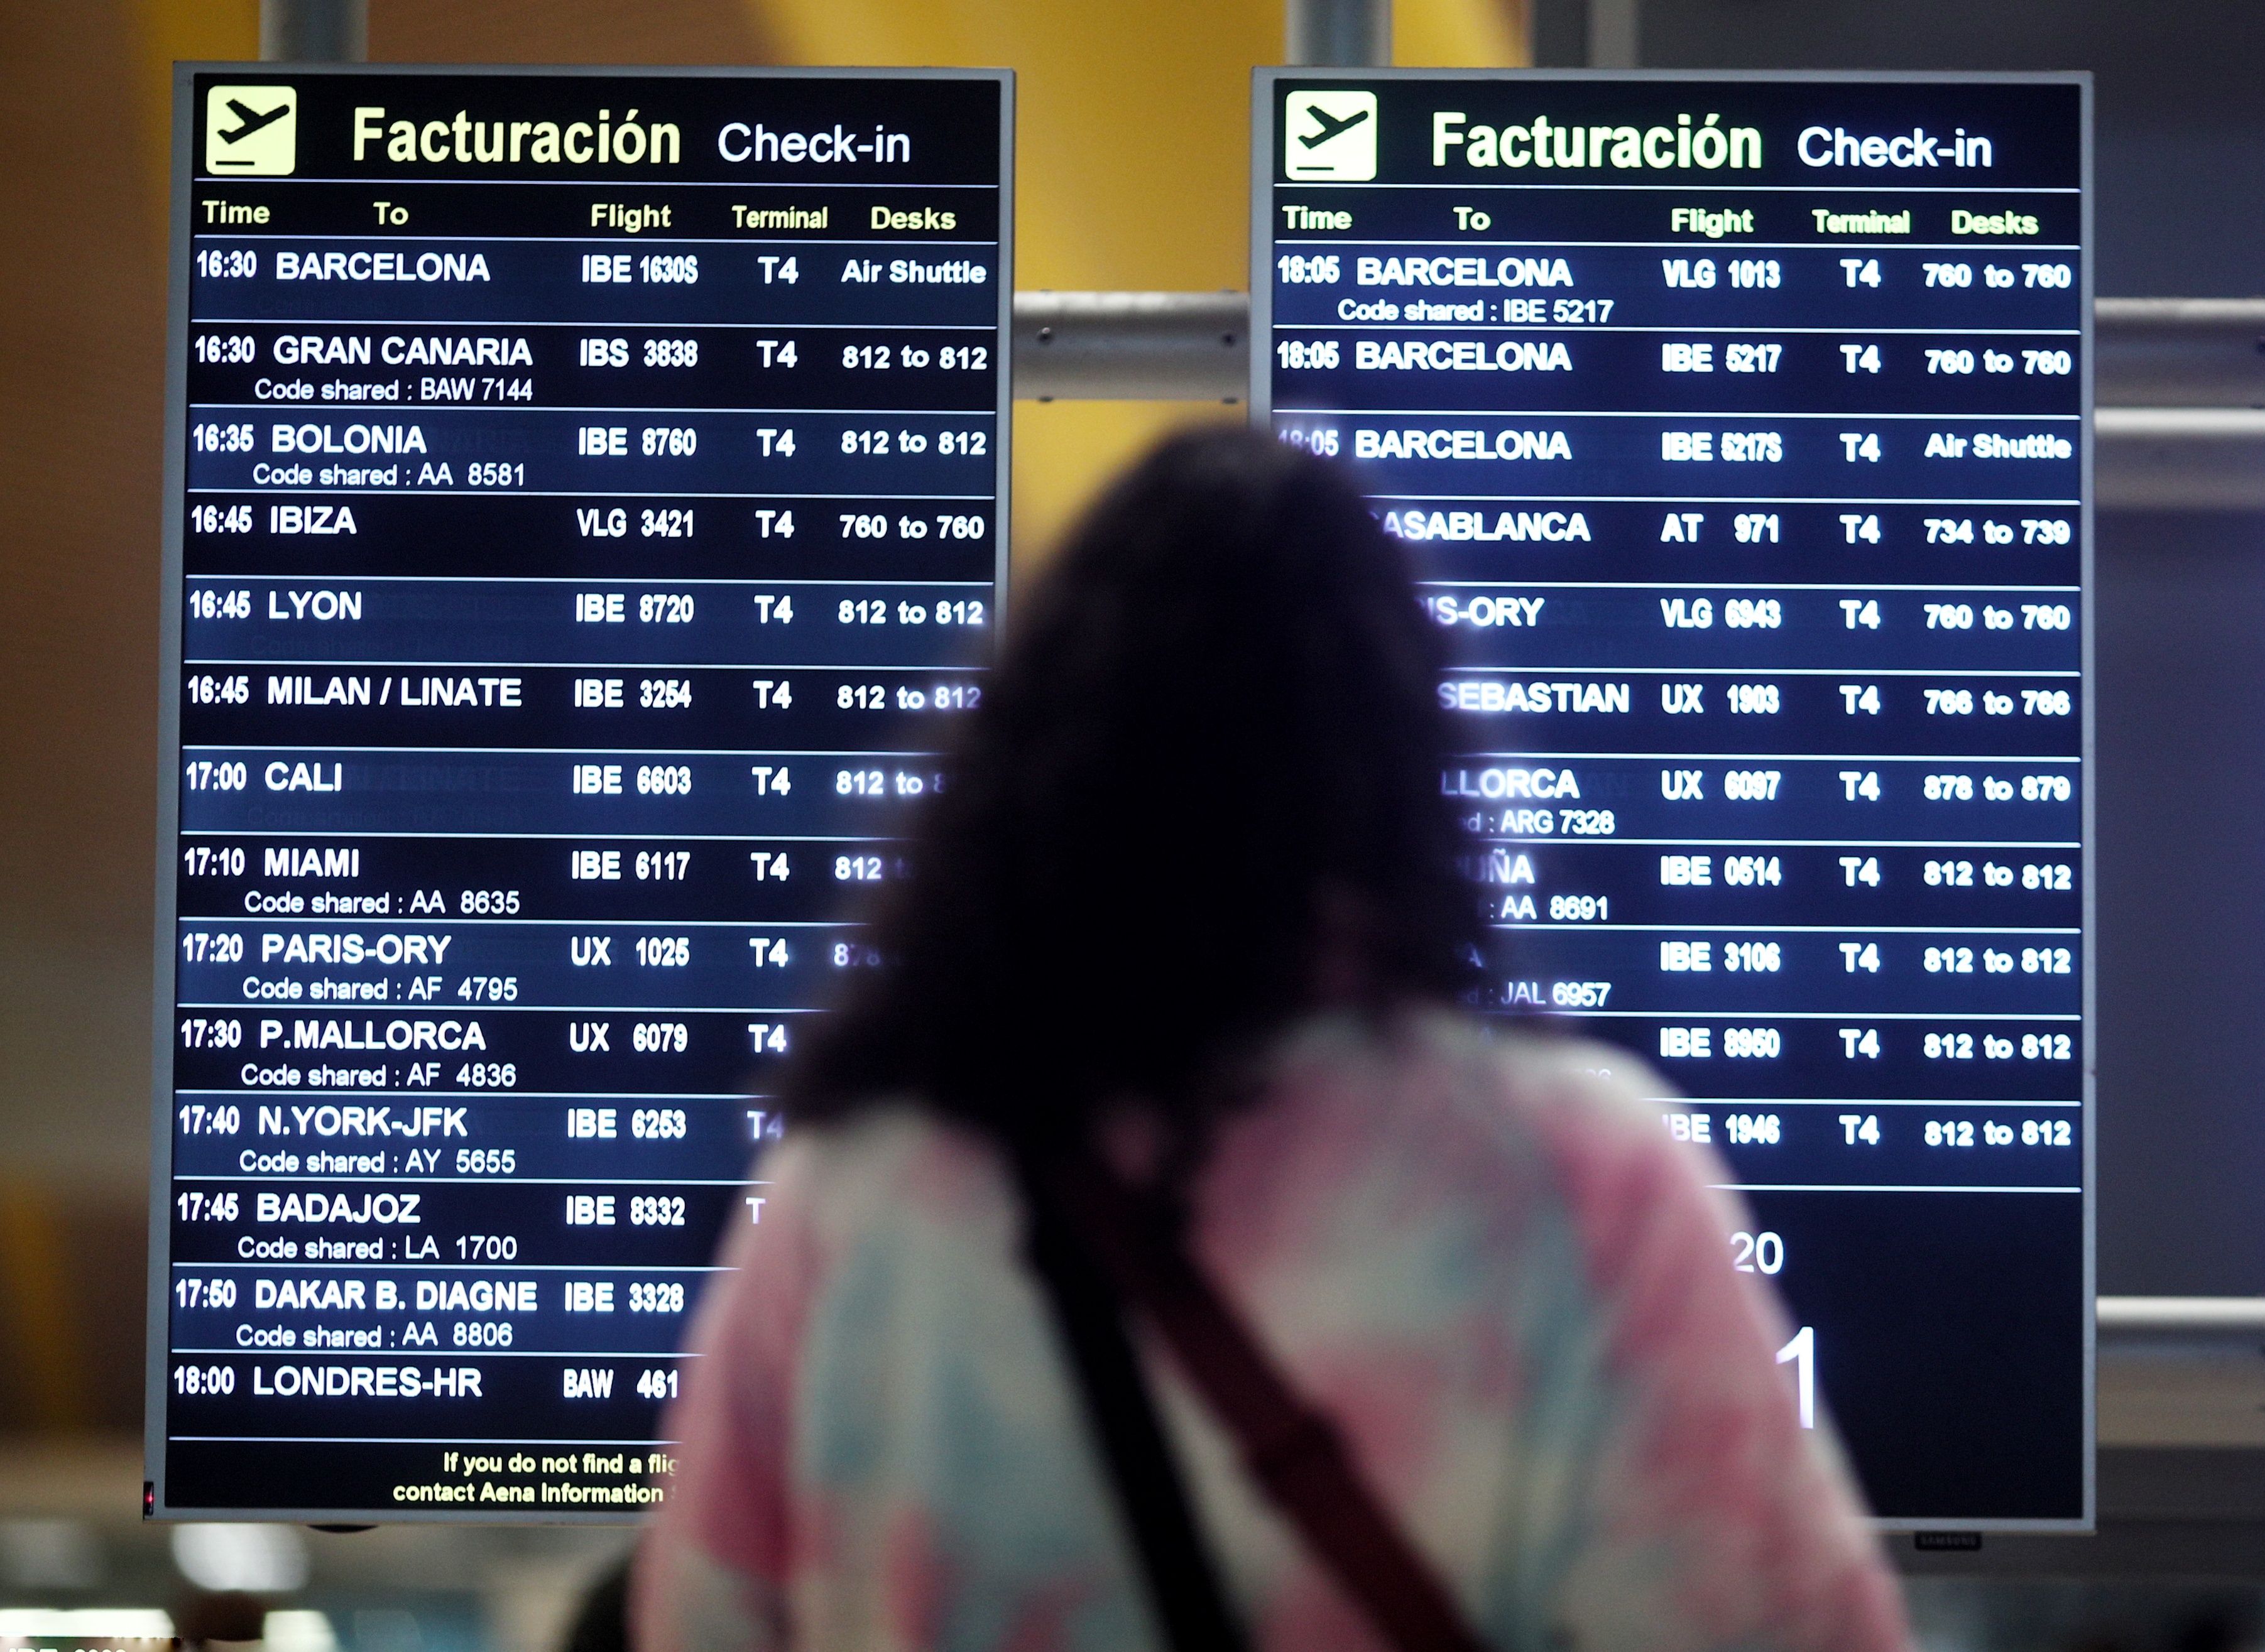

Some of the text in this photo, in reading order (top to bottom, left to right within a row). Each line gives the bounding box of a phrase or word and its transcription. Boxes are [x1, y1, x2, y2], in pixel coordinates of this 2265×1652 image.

[354, 107, 910, 164] Facturación Check-in
[1433, 112, 1992, 169] Facturación Check-in
[202, 200, 956, 233] Time To Flight Terminal Desks
[1282, 205, 2039, 239] Time To Flight Terminal Desks
[197, 249, 987, 285] 16:30 BARCELONA IBE 1630S T4 Air Shuttle
[1277, 254, 2072, 289] 18:05 BARCELONA VLG 1013 T4 760 to 760
[1337, 298, 1615, 323] Code shared IBE 5217
[195, 335, 988, 370] 16:30 GRAN CANARIA IBS 3838 T4 812 to 812
[1277, 340, 2072, 375] 18:05 BARCELONA IBE 5217 T4 760 to 760
[254, 377, 533, 401] Code shared BAW 7144
[193, 423, 986, 457] 16:35 BOLONIA IBE 8760 T4 812 to 812
[1355, 429, 2073, 463] BARCELONA IBE 5217S T4 Air Shuttle
[253, 462, 524, 486] Code shared AA 8581
[191, 504, 694, 538] 16:45 IBIZA VLG 3421
[1370, 511, 1882, 544] ASABLANCA AT 971 T4
[188, 675, 981, 710] 16:45 MILAN / LINATE IBE 3254 T4 812 to 812
[1436, 682, 1881, 715] SEBASTIAN UX 1903 T4
[186, 761, 792, 796] 17:00 CALI IBE 6603 T4
[1500, 810, 1554, 834] ARG
[1558, 809, 1616, 835] 7328
[184, 847, 790, 881] 17:10 MIAMI IBE 6117 T4
[244, 889, 520, 915] Code shared AA 8635
[1660, 941, 1882, 974] IBE 3106 T4
[1501, 982, 1546, 1006] JAL
[1549, 981, 1612, 1009] 6957
[179, 1104, 687, 1139] 17:40 N.YORK-JFK IBE 6253
[239, 1148, 516, 1174] Code shared AY 5655
[177, 1192, 685, 1226] 17:45 BADAJOZ IBE 8332
[1729, 1231, 1784, 1276] 20
[175, 1278, 684, 1315] 17:50 DAKAR B. DIAGNE IBE 3328
[174, 1365, 678, 1399] 18:00 LONDRES-HR BAW 461
[444, 1452, 642, 1477] If you do not find a
[393, 1482, 475, 1502] contact
[479, 1481, 535, 1503] Aena
[541, 1482, 664, 1503] Information
